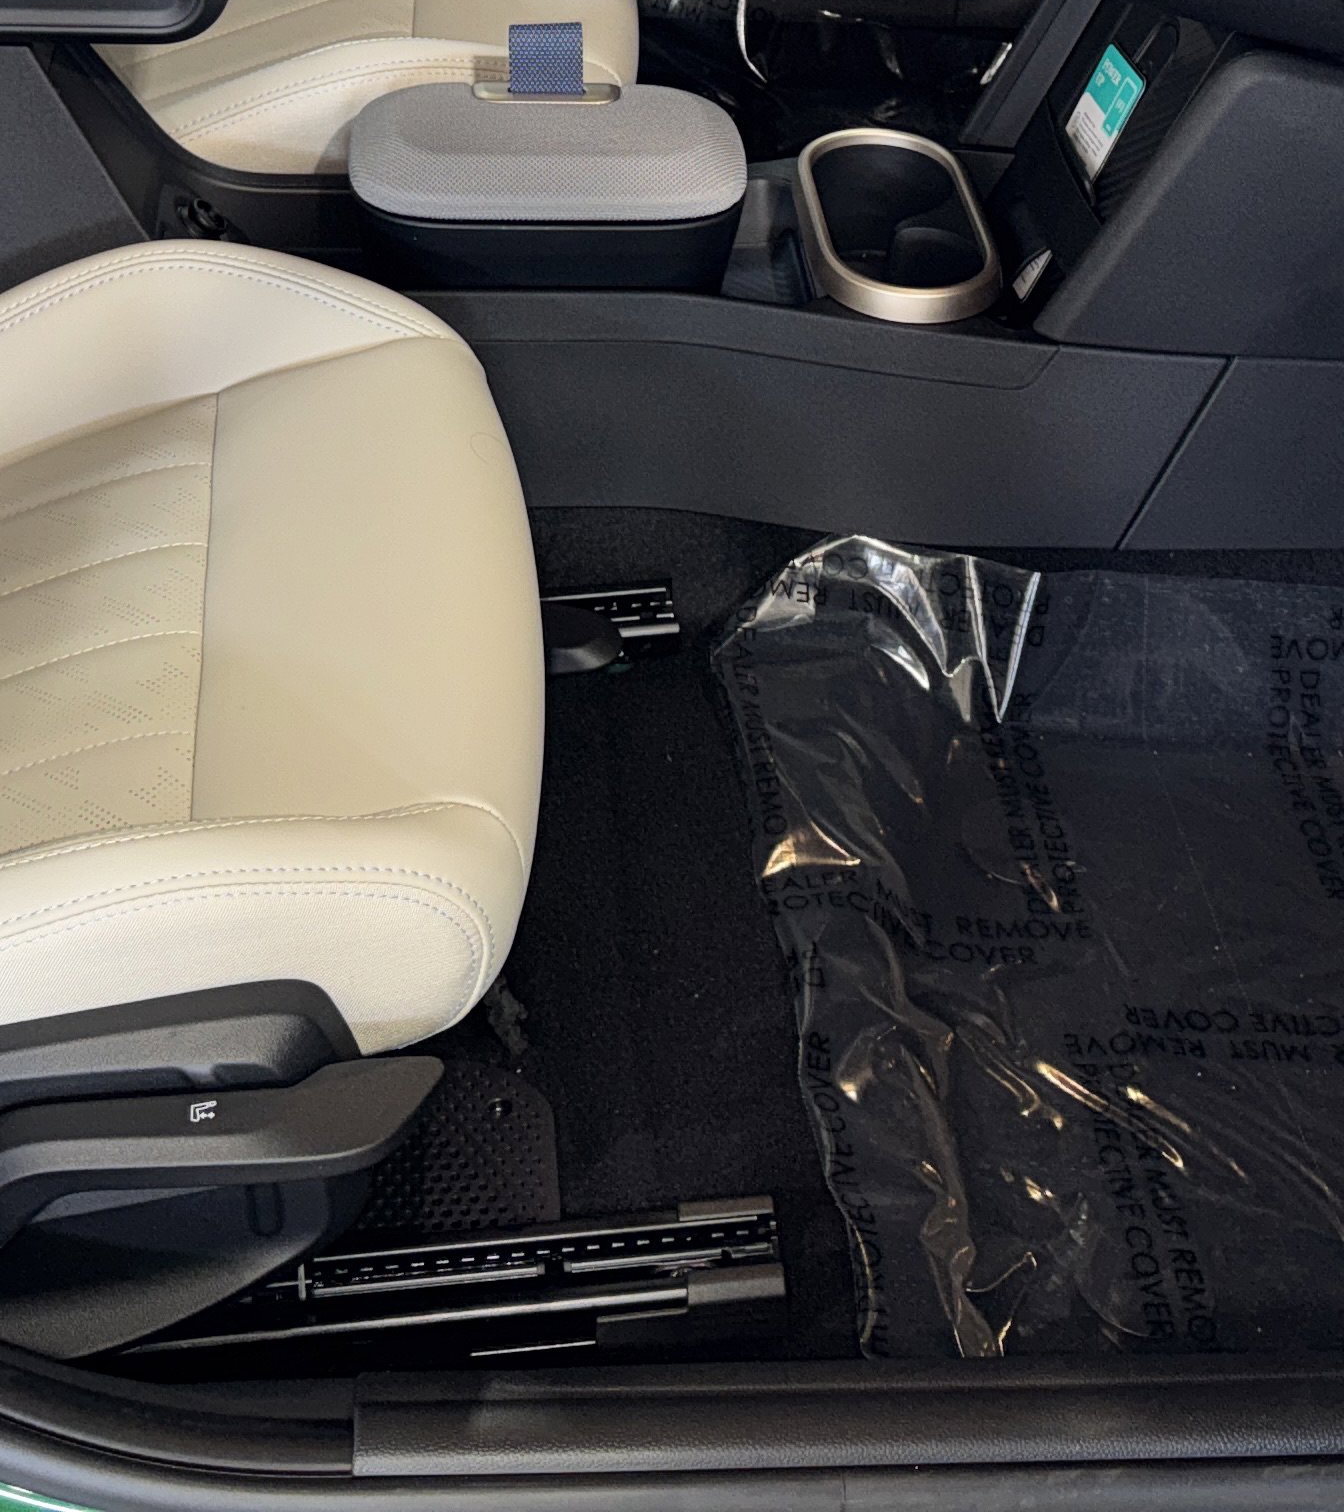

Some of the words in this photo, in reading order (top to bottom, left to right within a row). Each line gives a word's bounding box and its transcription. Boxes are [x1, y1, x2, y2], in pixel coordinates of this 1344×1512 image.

[1267, 668, 1317, 818] PROTECTIVE
[760, 870, 858, 897] EALER
[955, 916, 1093, 941] REMOVE
[920, 938, 1038, 964] COVER
[1063, 1031, 1207, 1059] REMOVE
[1125, 1004, 1240, 1033] COVER
[1229, 1038, 1313, 1063] MUST
[807, 1031, 847, 1134] COVER
[1124, 1225, 1175, 1340] COVER
[1167, 1245, 1218, 1344] REMO
